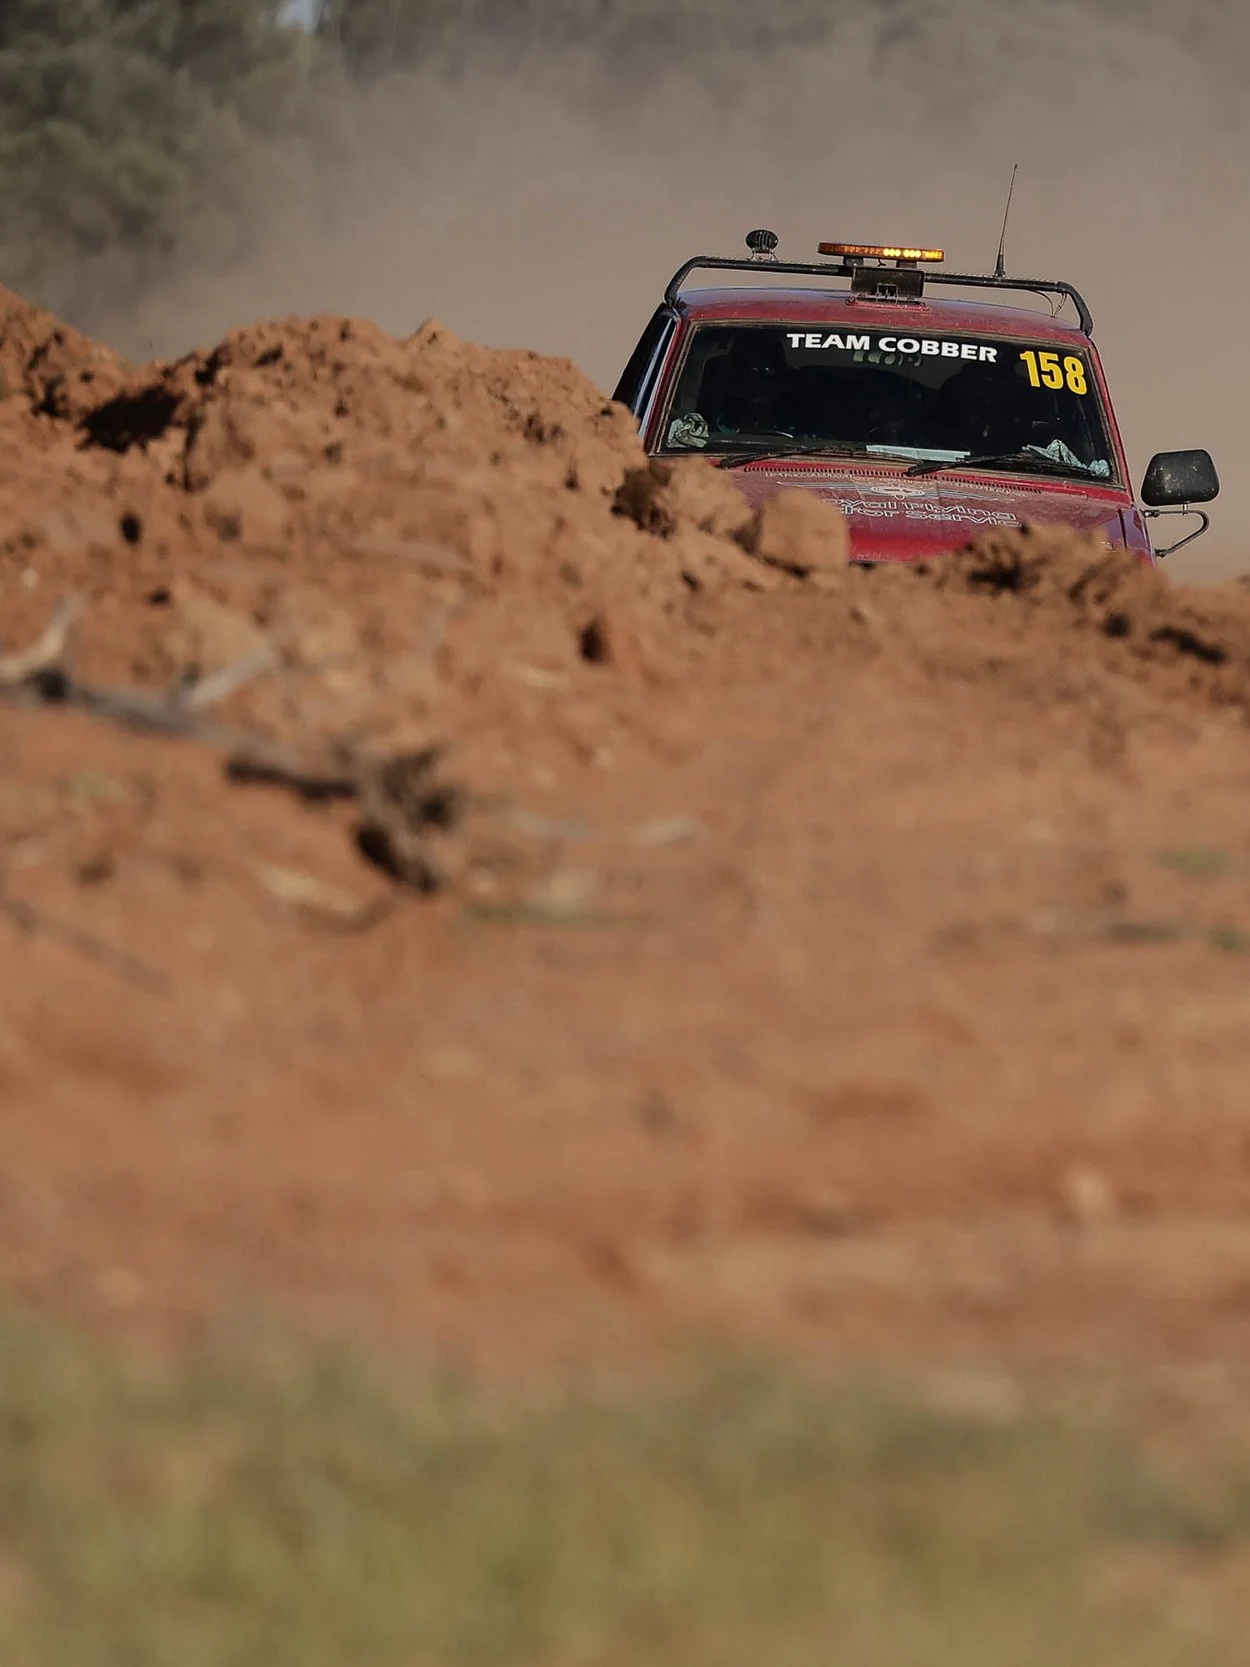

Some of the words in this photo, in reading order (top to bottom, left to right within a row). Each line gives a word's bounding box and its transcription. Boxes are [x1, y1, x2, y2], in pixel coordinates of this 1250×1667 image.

[786, 333, 870, 350] TEAM
[878, 336, 998, 363] COBBER
[1020, 350, 1088, 395] 158
[905, 510, 1022, 528] Servic
